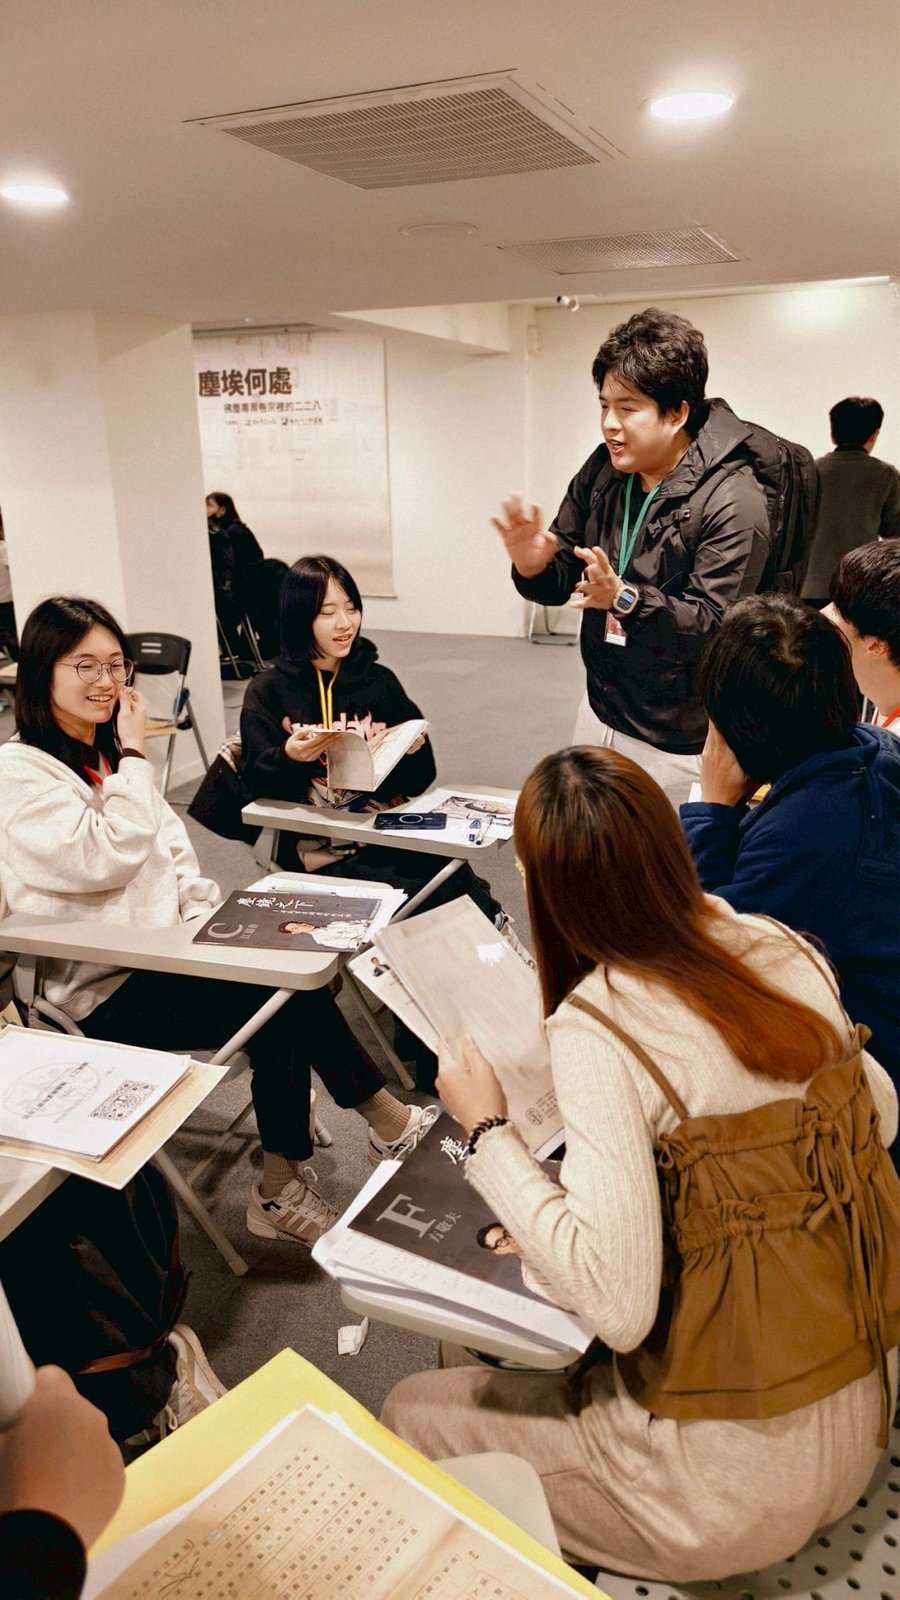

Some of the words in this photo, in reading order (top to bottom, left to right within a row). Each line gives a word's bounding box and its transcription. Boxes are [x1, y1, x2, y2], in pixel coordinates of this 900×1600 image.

[198, 367, 292, 397] 塵埃何處
[376, 1193, 437, 1238] F
